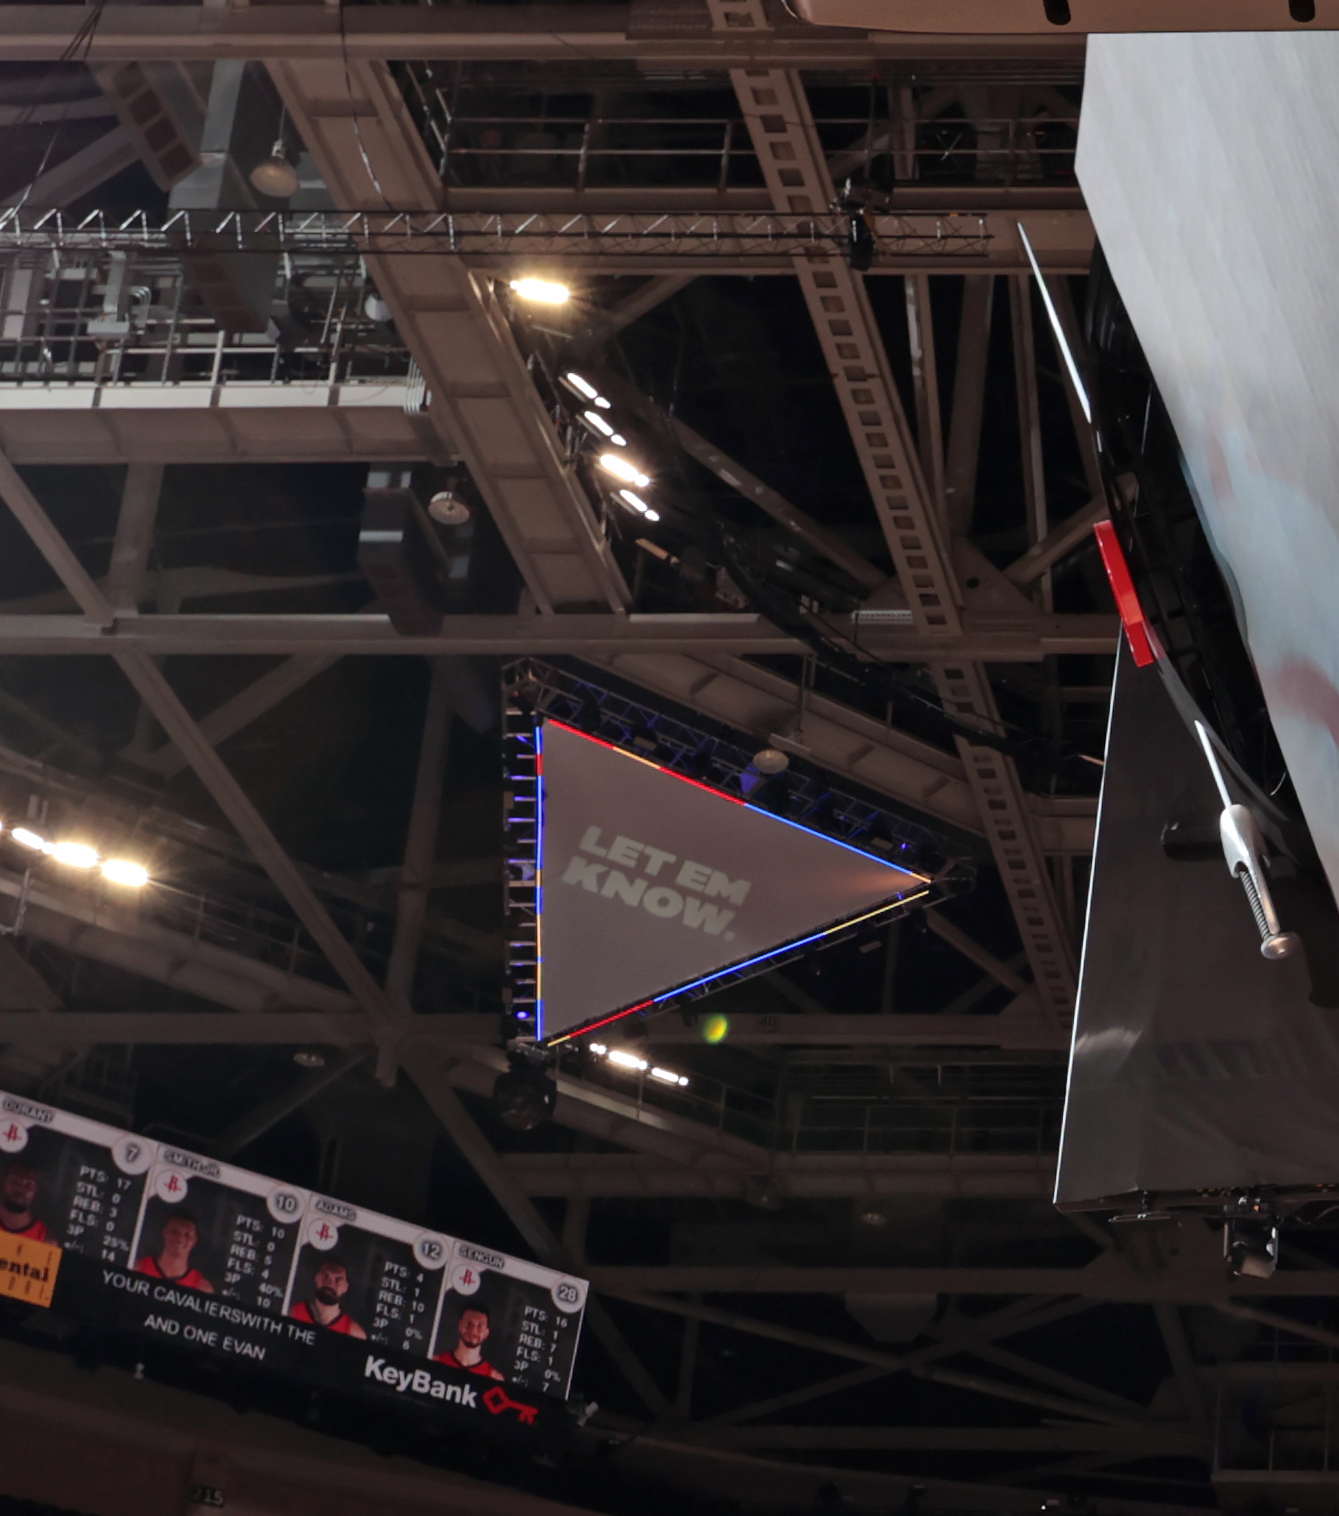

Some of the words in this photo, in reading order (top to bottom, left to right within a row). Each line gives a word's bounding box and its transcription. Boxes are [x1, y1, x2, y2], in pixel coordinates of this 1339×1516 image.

[578, 825, 677, 876] LET
[675, 859, 751, 906] EM
[561, 855, 736, 941] KNOW.
[277, 1195, 296, 1211] 10
[423, 1242, 440, 1259] 12
[102, 1269, 149, 1296] YOUR
[286, 1323, 316, 1345] THE
[559, 1286, 578, 1301] 28
[145, 1314, 180, 1336] AND
[183, 1324, 217, 1346] ONE
[223, 1336, 266, 1361] EVAN
[365, 1355, 478, 1408] KeyBank
